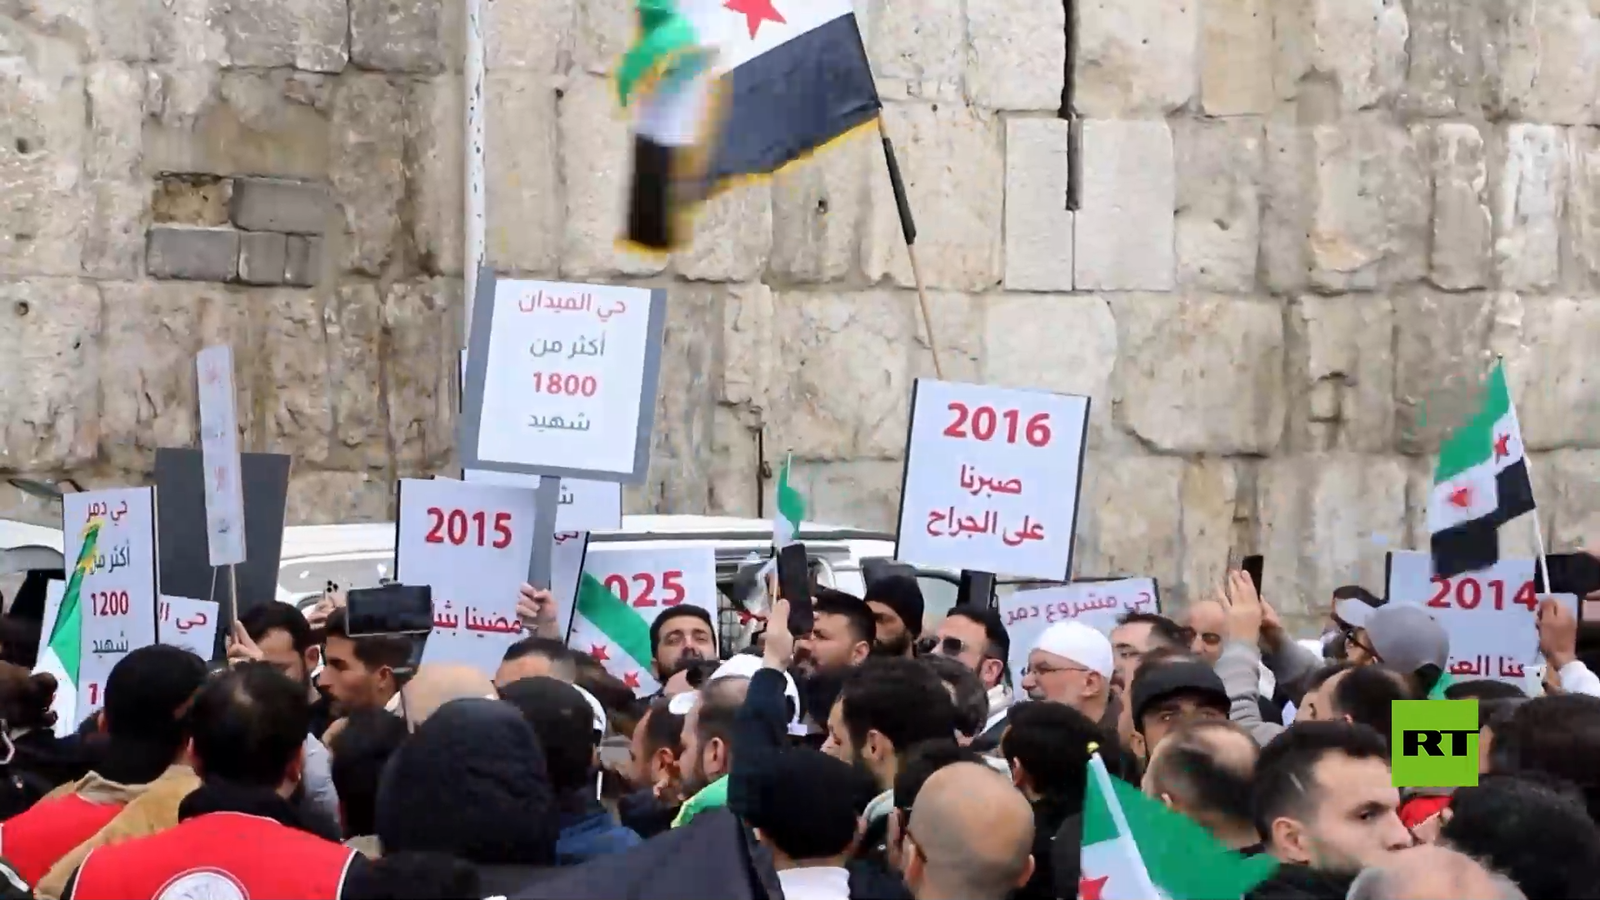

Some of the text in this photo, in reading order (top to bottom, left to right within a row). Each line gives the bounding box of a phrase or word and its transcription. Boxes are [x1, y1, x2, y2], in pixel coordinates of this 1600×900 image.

[518, 289, 626, 322] حي الميدان
[529, 330, 606, 359] أكثر من
[533, 371, 597, 397] 1800
[528, 411, 590, 432] شهيد
[943, 402, 1051, 447] 2016
[960, 464, 1022, 498] صبرنا
[86, 501, 128, 526] حي دمر
[425, 507, 513, 549] 2015
[926, 506, 1044, 546] على الجراح
[108, 538, 131, 574] أكثر
[90, 590, 129, 616] 1200
[603, 570, 686, 608] 025
[1427, 574, 1539, 612] 2014
[176, 611, 208, 634] حي
[465, 606, 522, 638] مضينا
[1007, 591, 1151, 625] حي مشروع دمر
[92, 631, 129, 658] شهيد
[1449, 654, 1490, 676] العن
